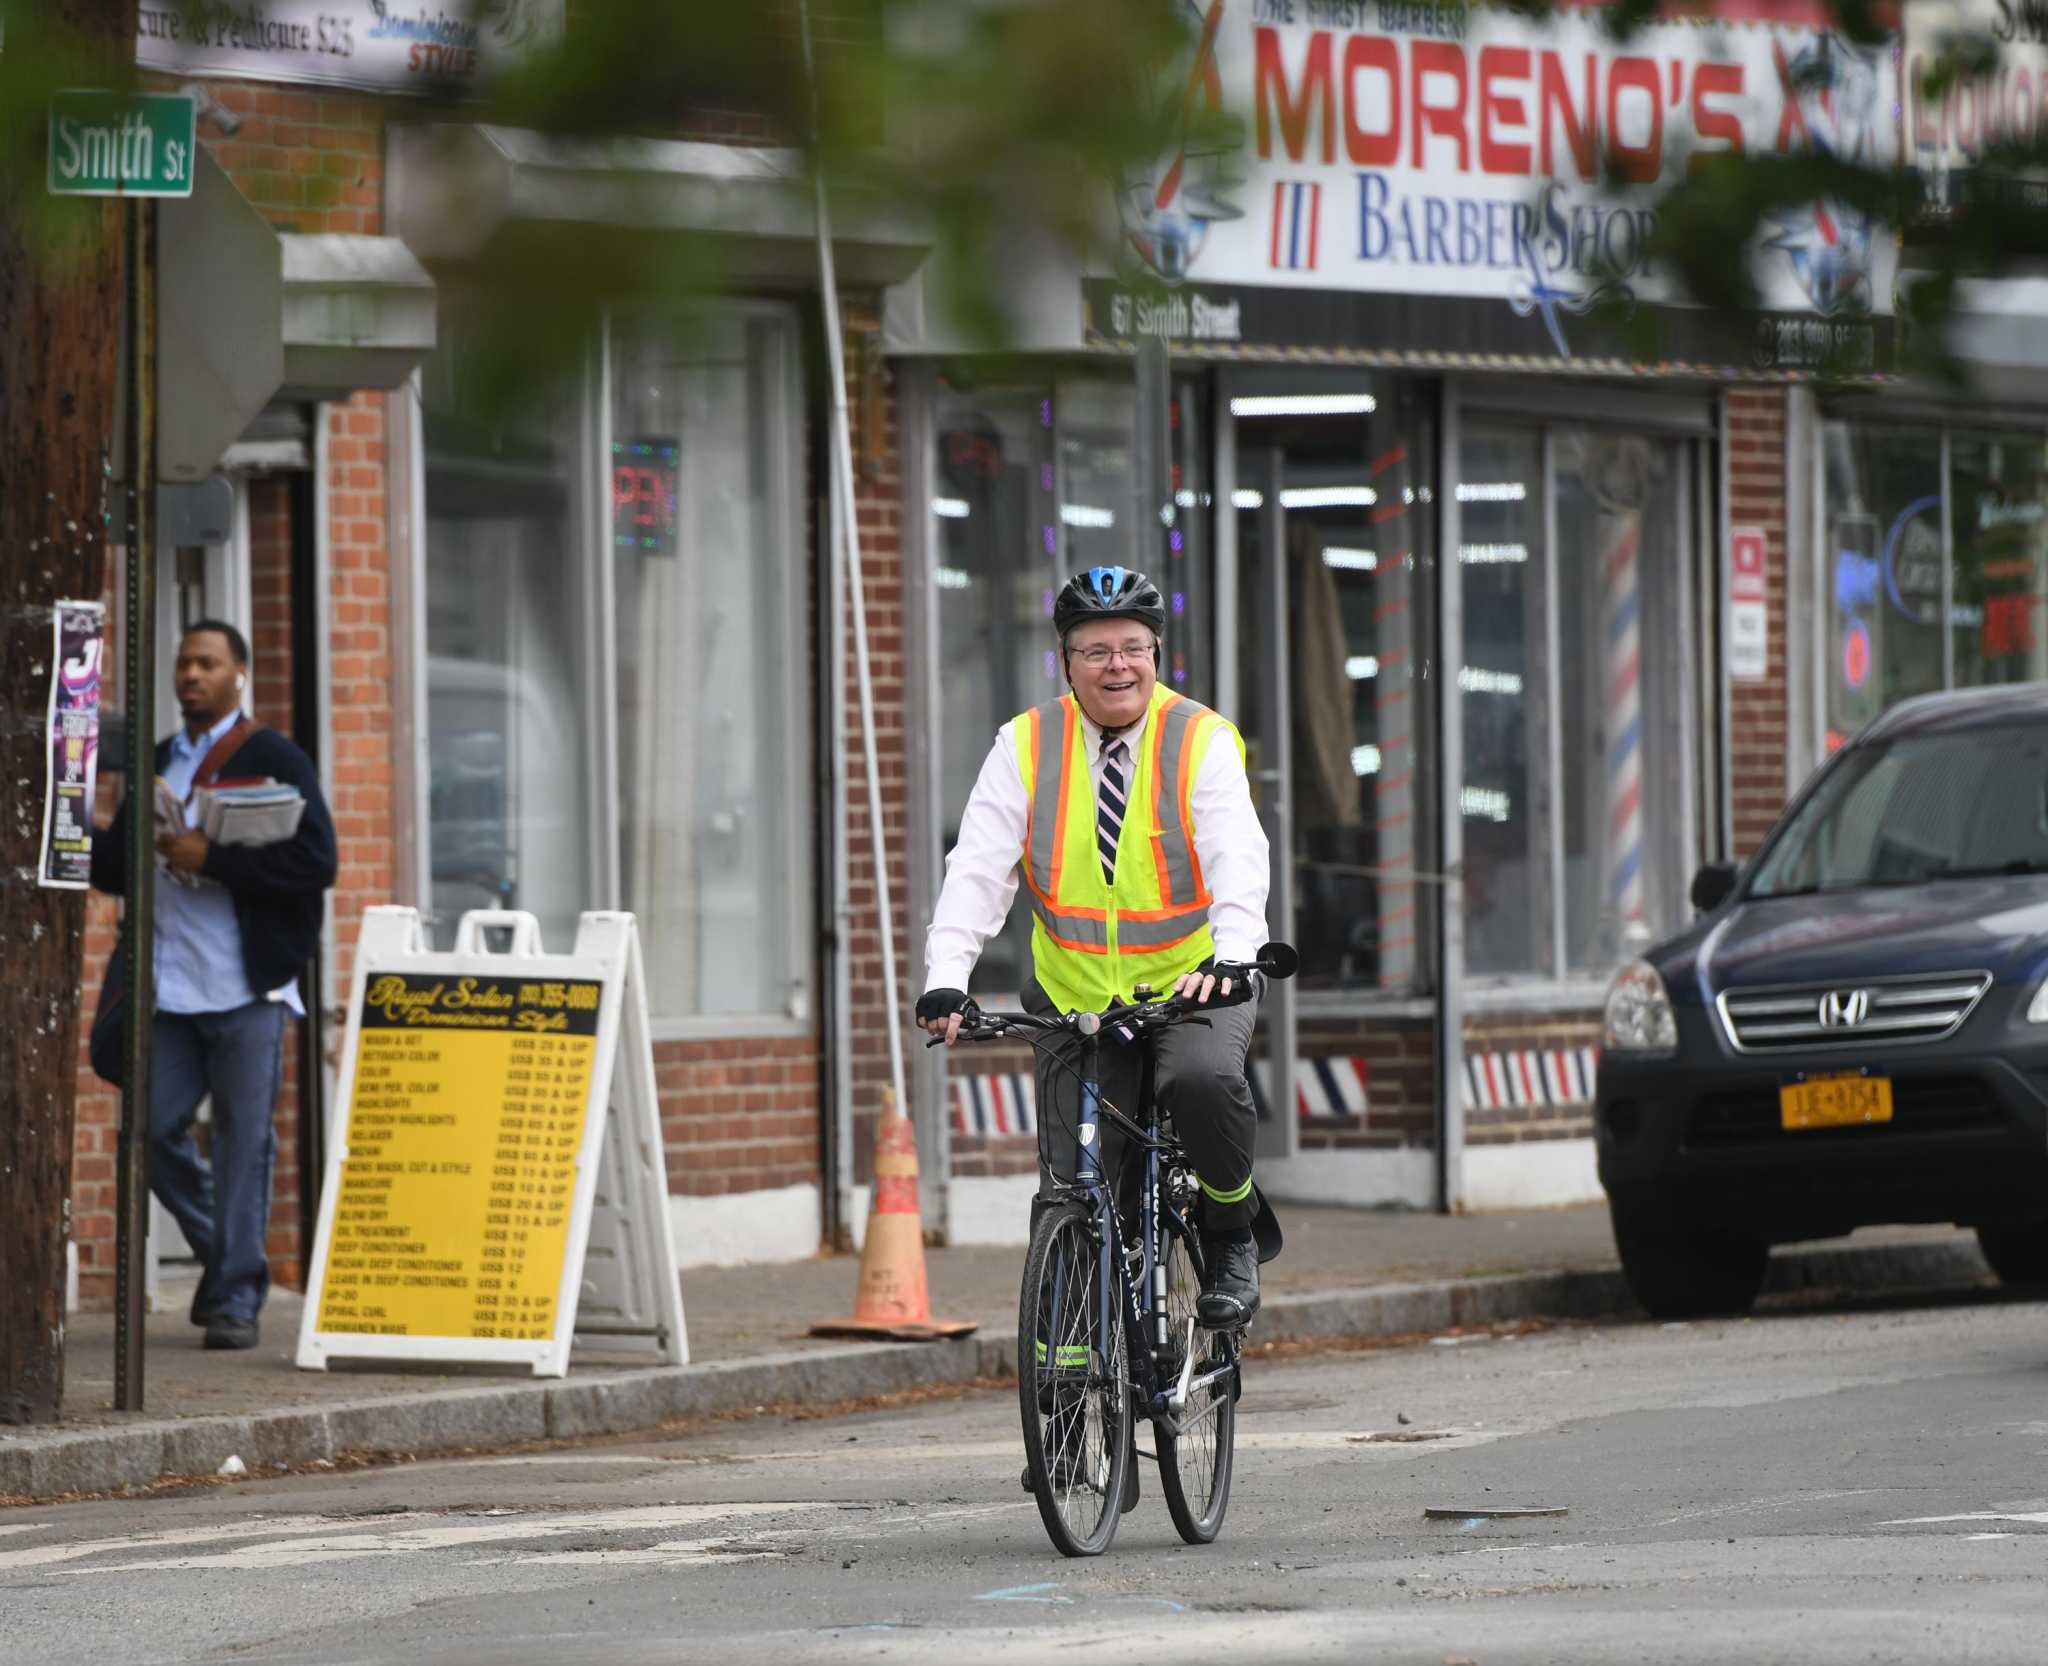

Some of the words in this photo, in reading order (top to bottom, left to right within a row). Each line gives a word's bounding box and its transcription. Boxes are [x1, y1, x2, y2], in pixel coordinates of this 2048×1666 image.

[215, 14, 311, 51] Pedicure
[407, 42, 476, 74] STYLE
[1253, 26, 1745, 183] MORENO'S
[57, 112, 154, 180] Smith
[162, 139, 187, 181] St
[1136, 293, 1189, 337] Smith
[1191, 293, 1240, 340] Street
[405, 1007, 509, 1025] Dominican
